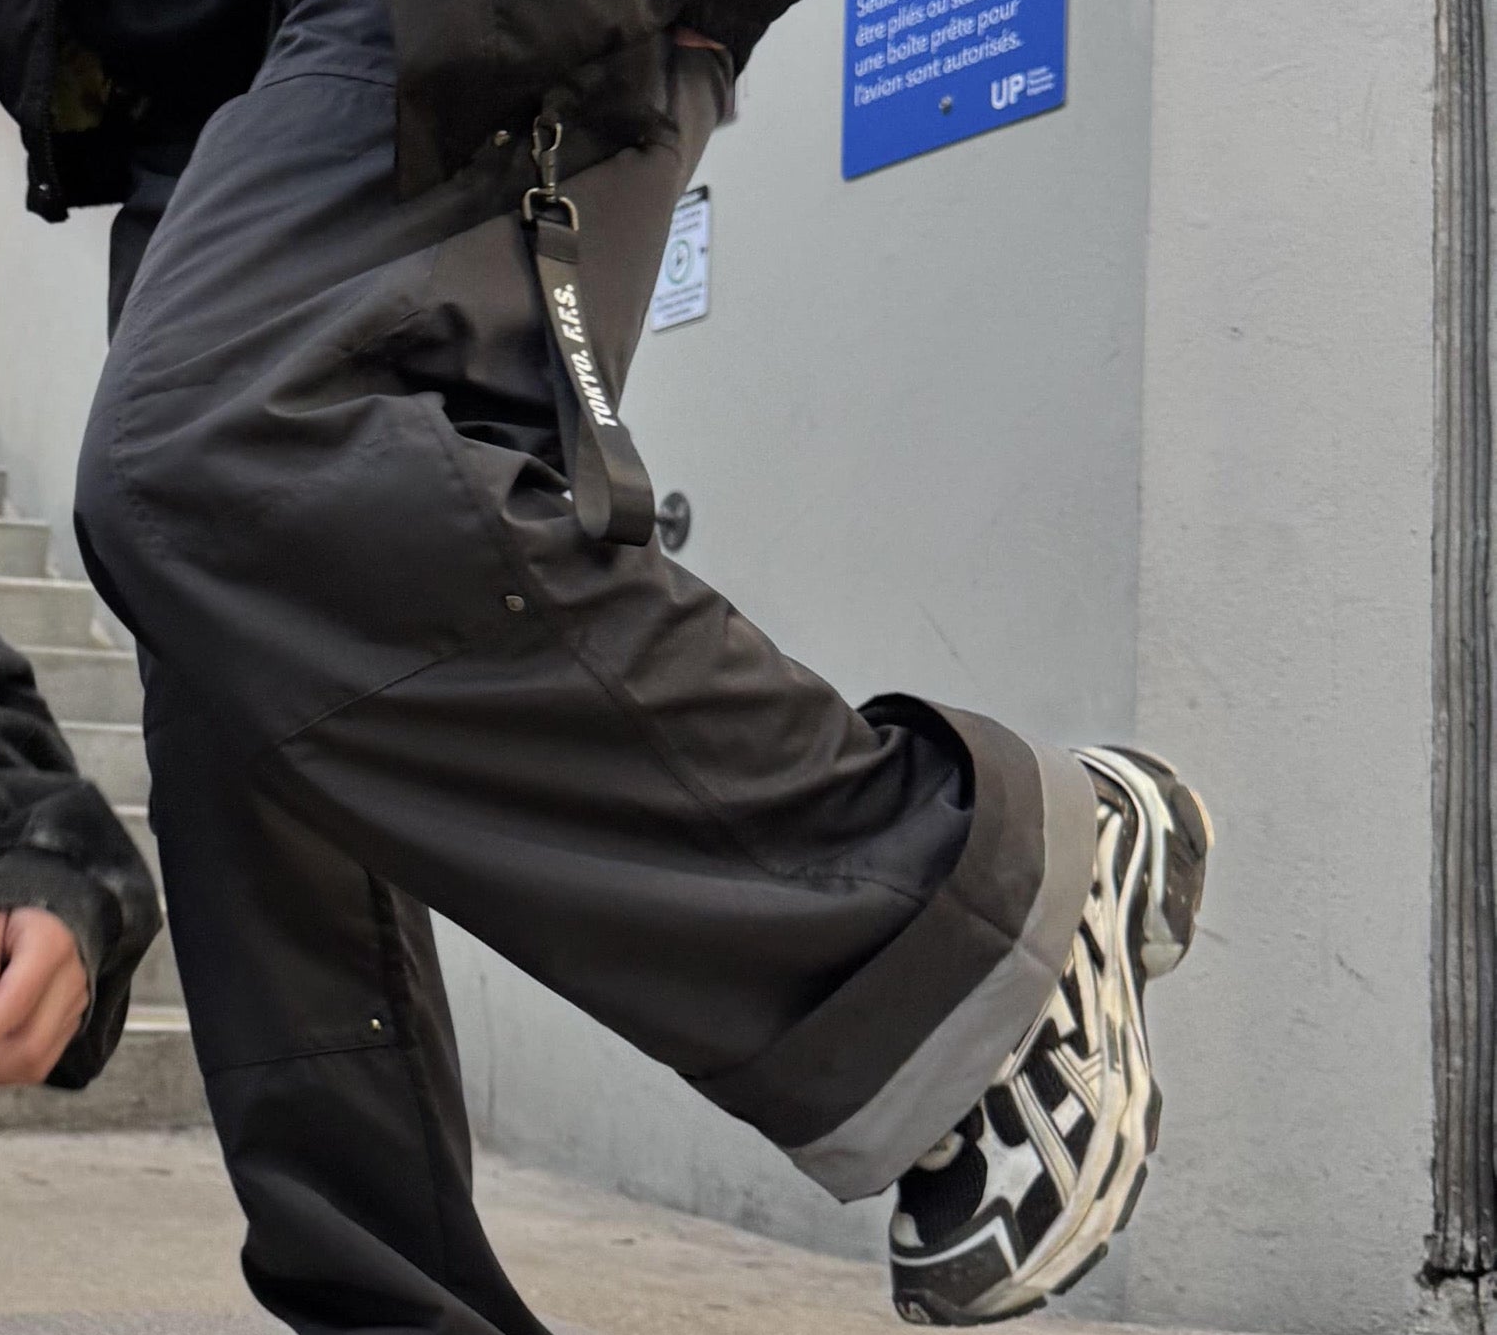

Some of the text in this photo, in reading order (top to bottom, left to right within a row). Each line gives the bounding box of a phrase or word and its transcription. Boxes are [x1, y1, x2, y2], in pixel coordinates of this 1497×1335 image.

[855, 21, 887, 47] être
[887, 2, 926, 40] pliés
[855, 52, 885, 77] une
[904, 59, 942, 88] sont
[991, 73, 1026, 111] UP
[571, 349, 618, 427] TOKYO.
